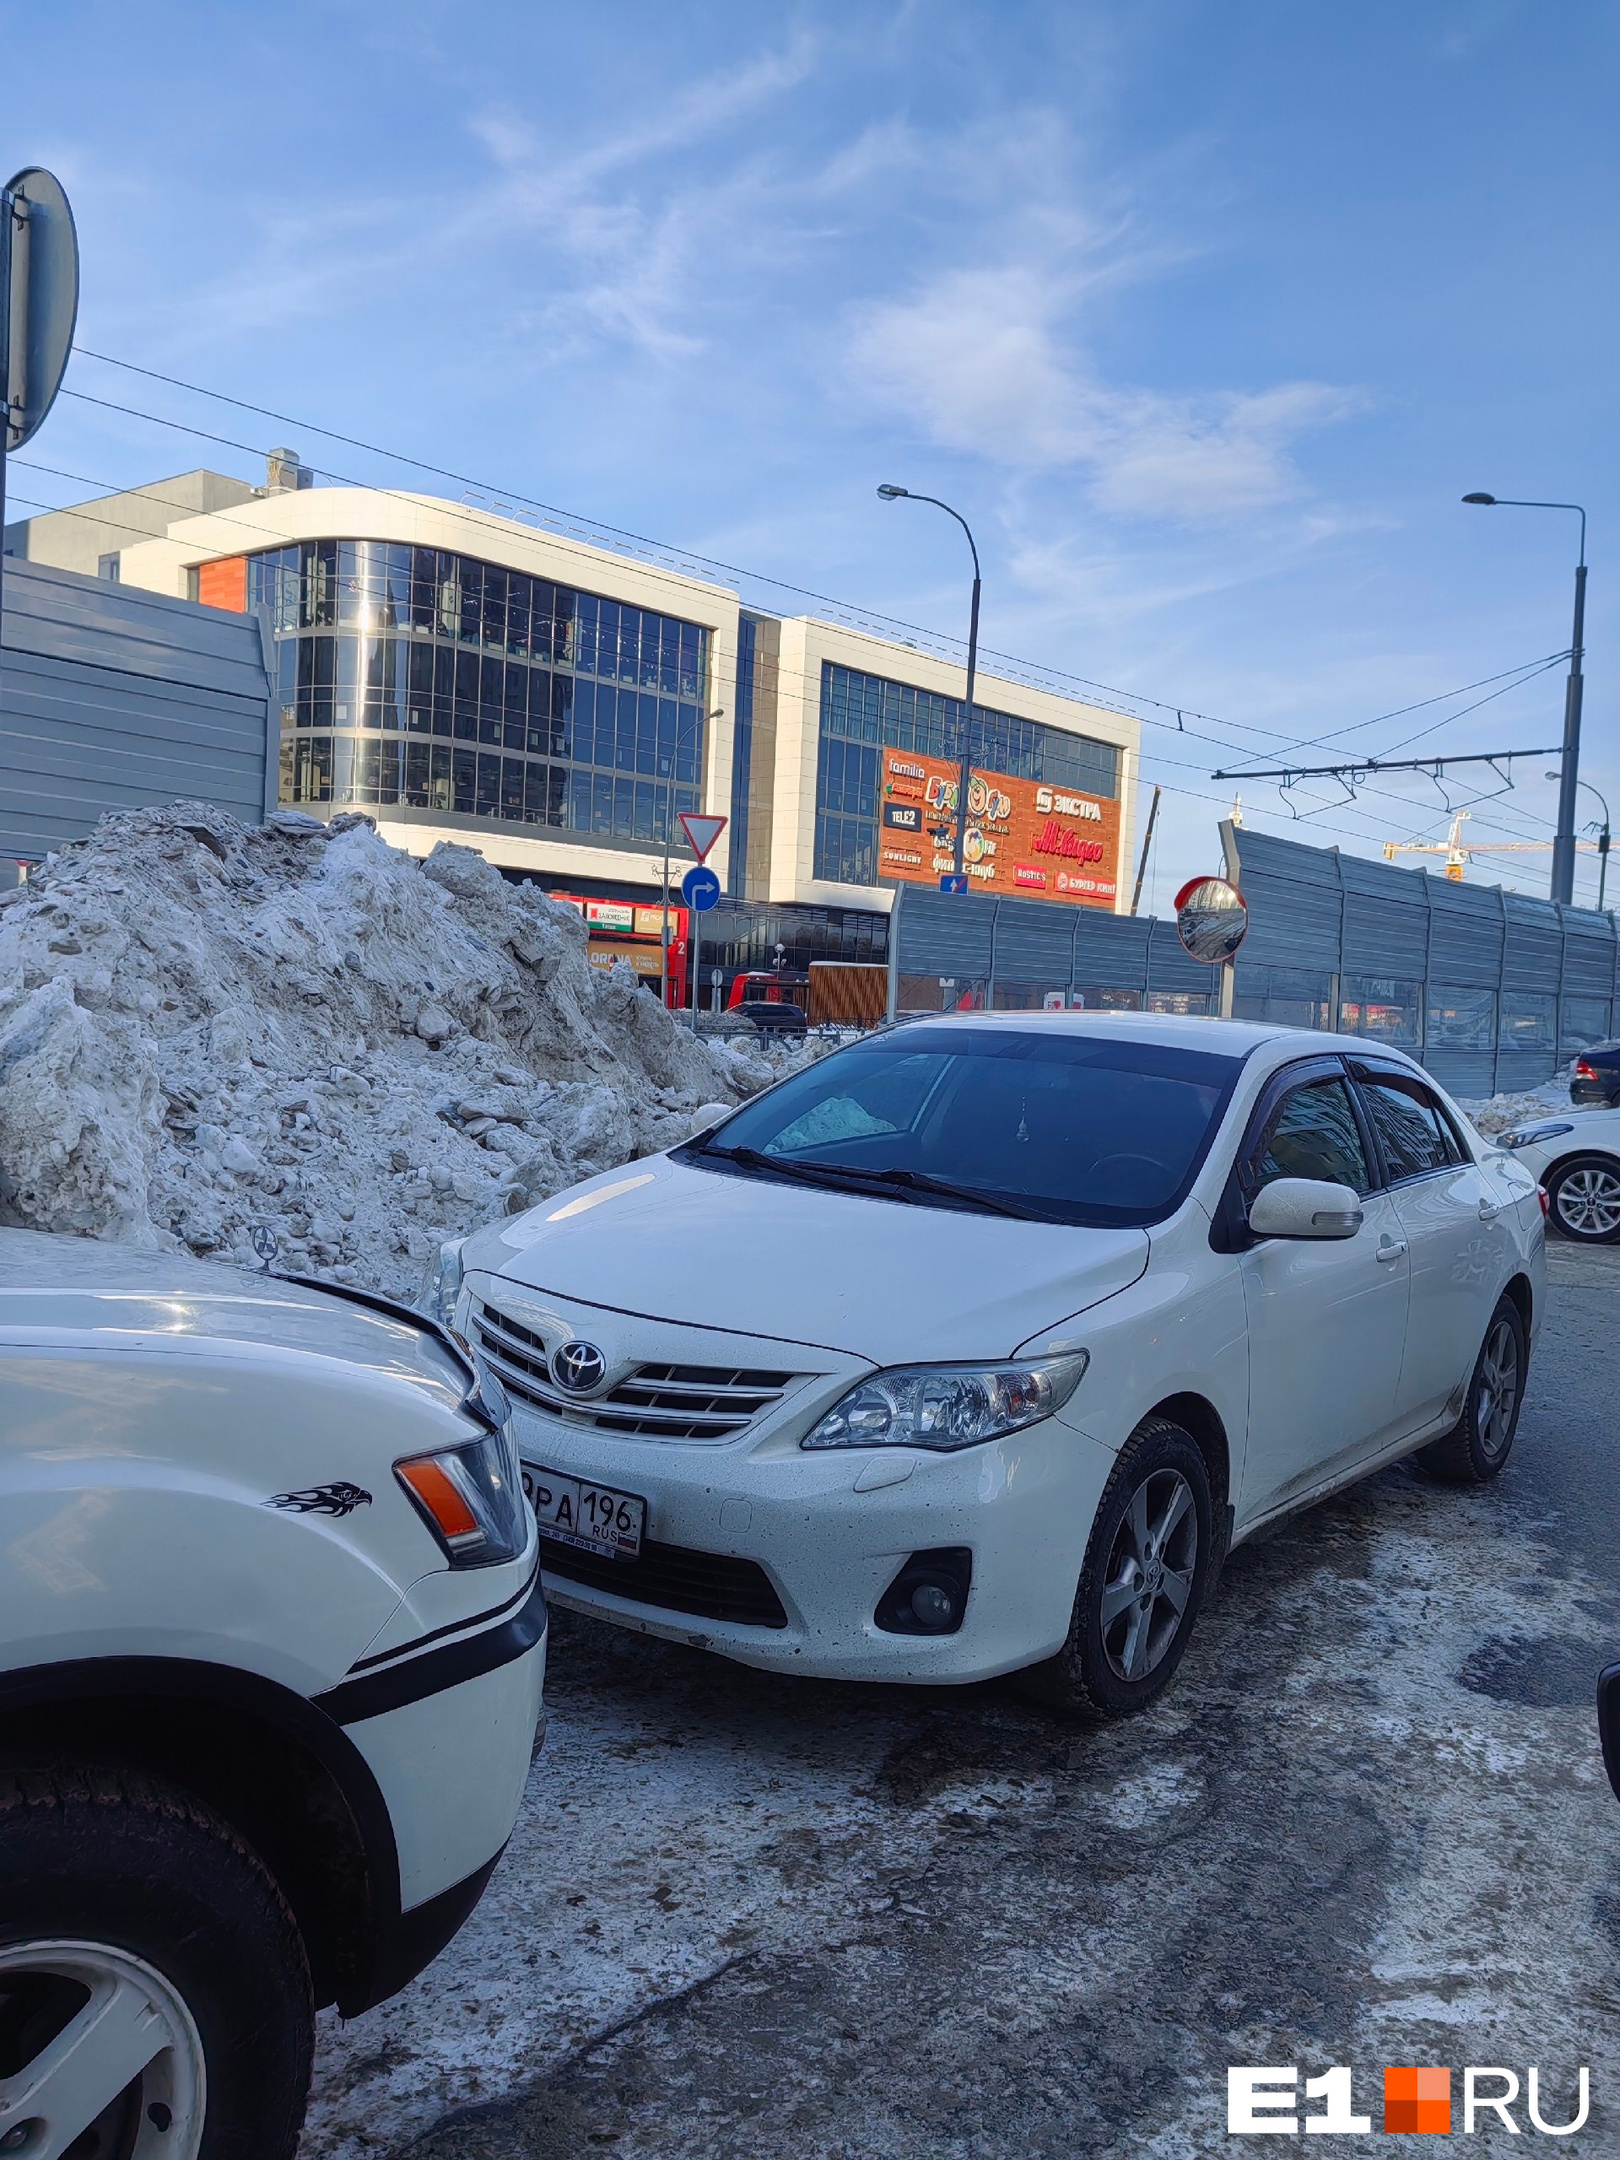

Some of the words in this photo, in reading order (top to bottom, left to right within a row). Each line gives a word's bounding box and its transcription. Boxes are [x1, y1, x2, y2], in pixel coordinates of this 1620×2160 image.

[889, 758, 925, 779] familia
[1053, 794, 1101, 821] ЭКСТРА
[892, 810, 916, 826] TELE2
[883, 851, 922, 864] SUNLIGHT
[678, 942, 685, 955] 2
[583, 1491, 632, 1532] 196
[592, 1524, 618, 1542] RUS
